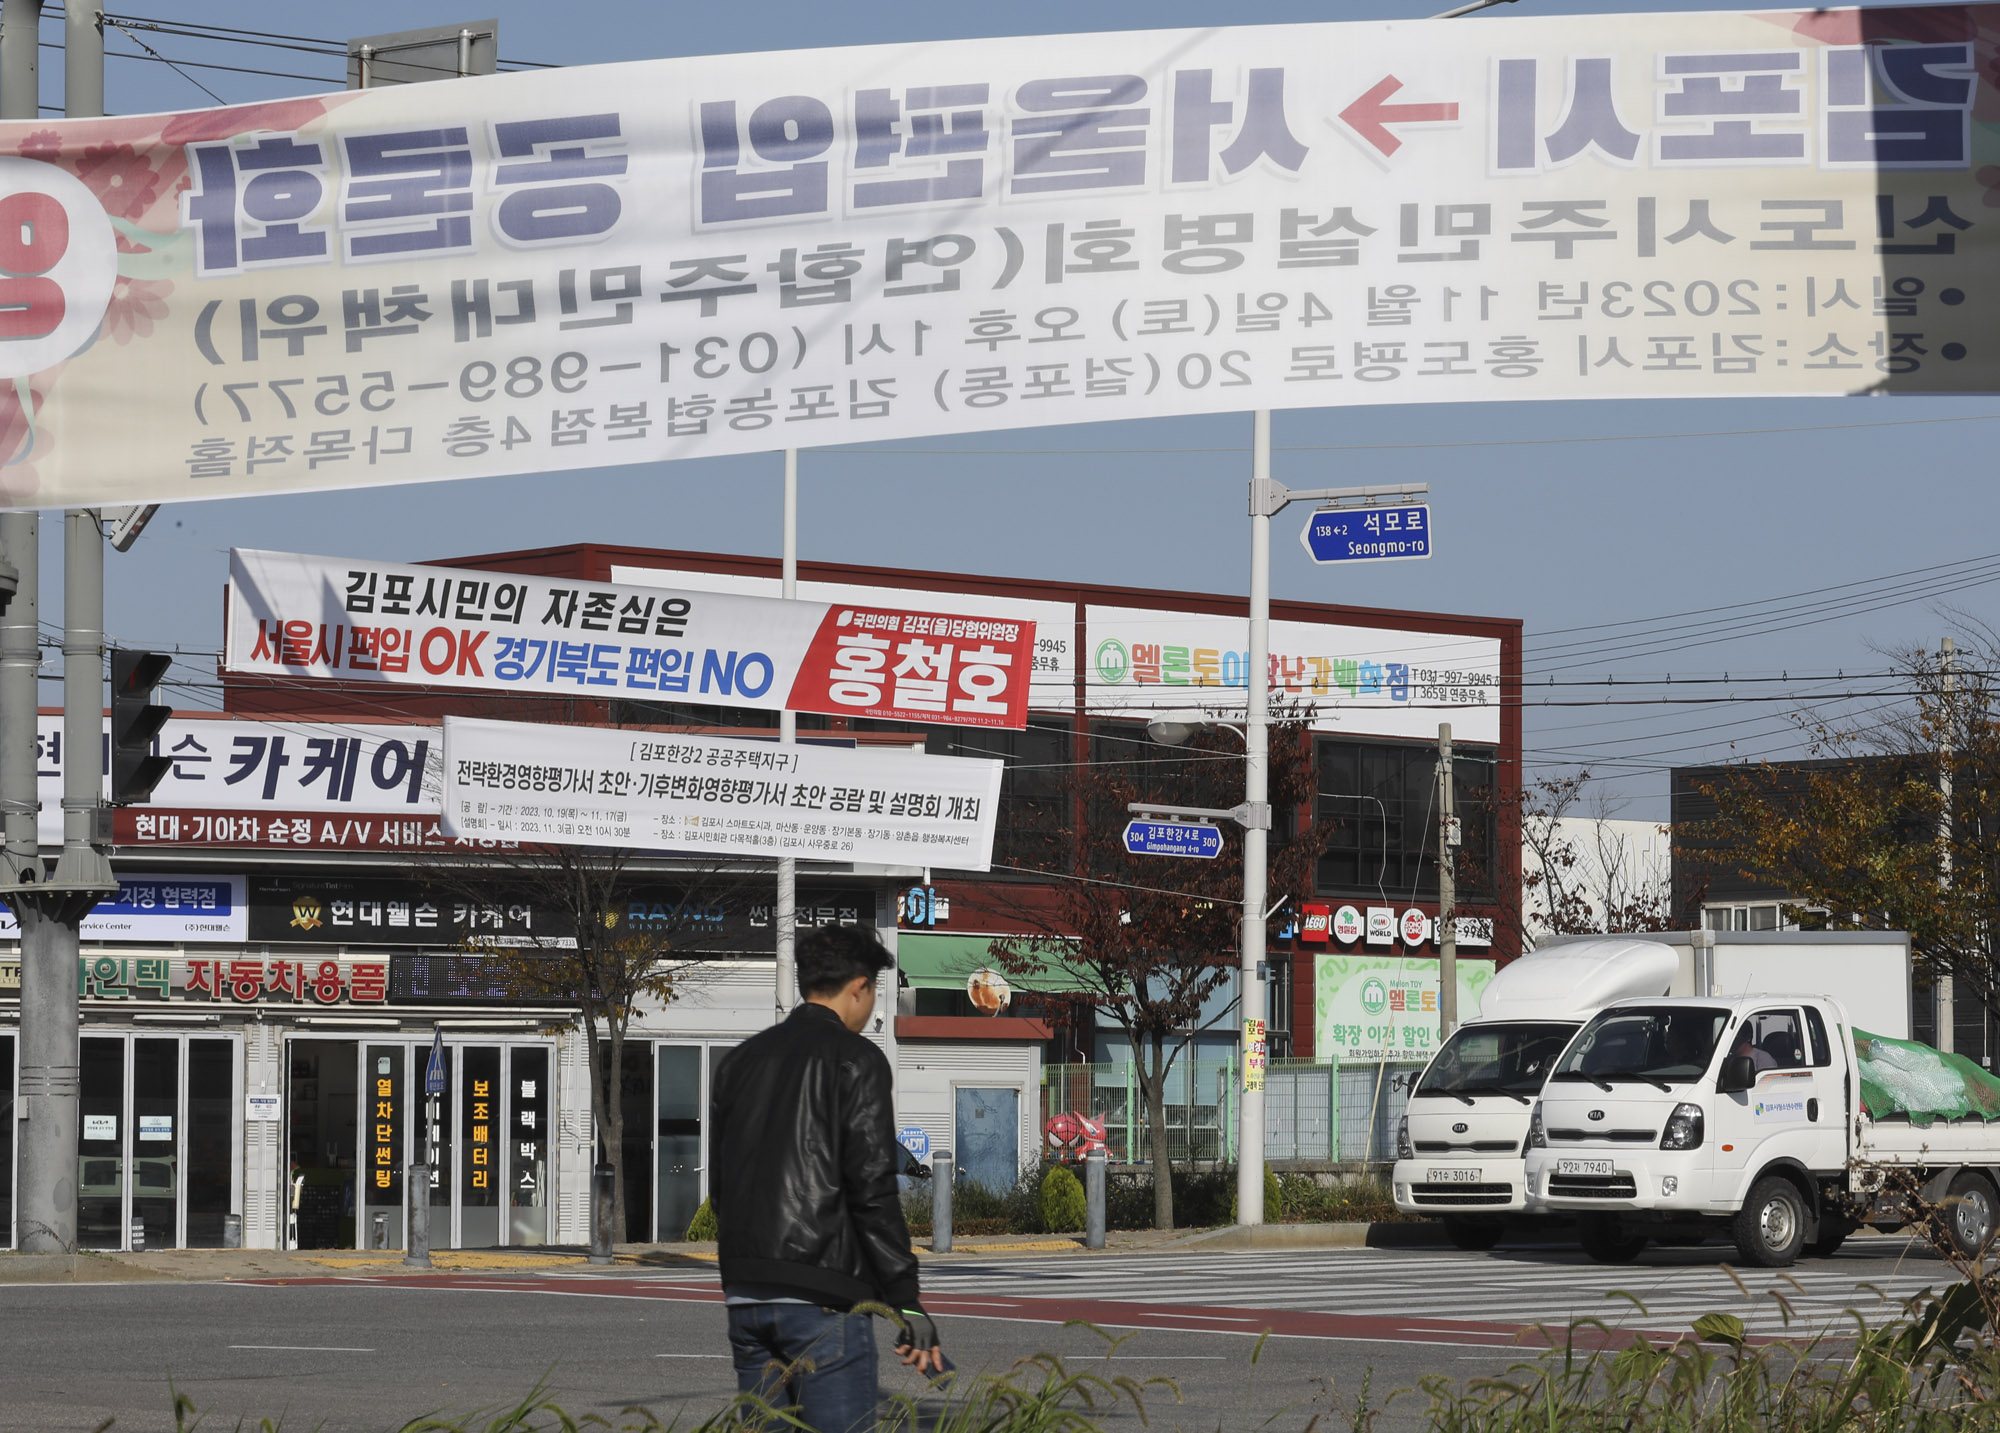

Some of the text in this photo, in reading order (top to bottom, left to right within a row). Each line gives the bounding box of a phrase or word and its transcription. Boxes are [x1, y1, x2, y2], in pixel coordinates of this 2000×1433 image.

[1316, 524, 1348, 537] 138 2
[1363, 511, 1424, 537] 석모로
[1348, 540, 1425, 556] Seongmo-ro
[345, 570, 692, 638] 김포시민의 자존심은
[853, 612, 1020, 643] 국민의힘 김포(을)당협위원장
[1033, 638, 1067, 654] -9945
[250, 619, 775, 700] 서울시 편입 OK 경기북도 편입 NO
[1031, 656, 1060, 672] 중무휴
[828, 632, 1013, 716] 홍철호
[1420, 670, 1493, 687] 031-997-9945
[1450, 687, 1488, 704] 연중무휴
[640, 742, 789, 772] 김포한강2 공공주택지구
[224, 736, 430, 803] 카케어
[457, 759, 594, 794] 전략환경영향평가서
[790, 784, 827, 810] 초안
[829, 787, 865, 812] 공람
[867, 790, 886, 814] 및
[889, 792, 941, 818] 설명회
[945, 795, 981, 822] 개최
[268, 818, 313, 845] 순정
[319, 820, 372, 845] A/V
[379, 820, 446, 847] 서비스
[498, 804, 512, 816] 기간
[661, 814, 676, 825] 장소
[701, 816, 724, 828] 김포시
[922, 831, 970, 846] 행정복지센터
[498, 819, 512, 831] 일시
[577, 825, 593, 836] 오전
[595, 826, 612, 837] 10시
[613, 826, 631, 838] 30분
[661, 829, 676, 840] 장소
[684, 830, 728, 843] 김포시민회관
[1130, 831, 1144, 842] 304
[1148, 826, 1200, 842] 김포한강4로
[1146, 841, 1186, 854] Gimpohangang
[1202, 837, 1217, 848] 300
[120, 886, 216, 911] 지정 협력점
[79, 921, 133, 931] ervice Center
[330, 899, 533, 930] 현대웰슨 카케어
[748, 905, 858, 928] 썬전문점
[1304, 915, 1327, 931] LEGO
[1370, 929, 1392, 937] WORLD
[184, 960, 387, 1003] 자동차용품
[1390, 980, 1423, 989] Melon TOY
[1389, 989, 1441, 1012] 멜론토
[1333, 1024, 1362, 1047] 확장
[1367, 1025, 1396, 1047] 이전
[1402, 1025, 1431, 1047] 할인
[1589, 1111, 1604, 1119] KIA
[376, 1078, 393, 1188] 열차단썬팅
[473, 1080, 489, 1188] 보조배터리
[520, 1080, 537, 1189] 블랙박스
[1453, 1124, 1467, 1132] KIA
[903, 1137, 924, 1151] ADT
[1453, 1171, 1475, 1181] 3016
[1584, 1161, 1608, 1174] 7940
